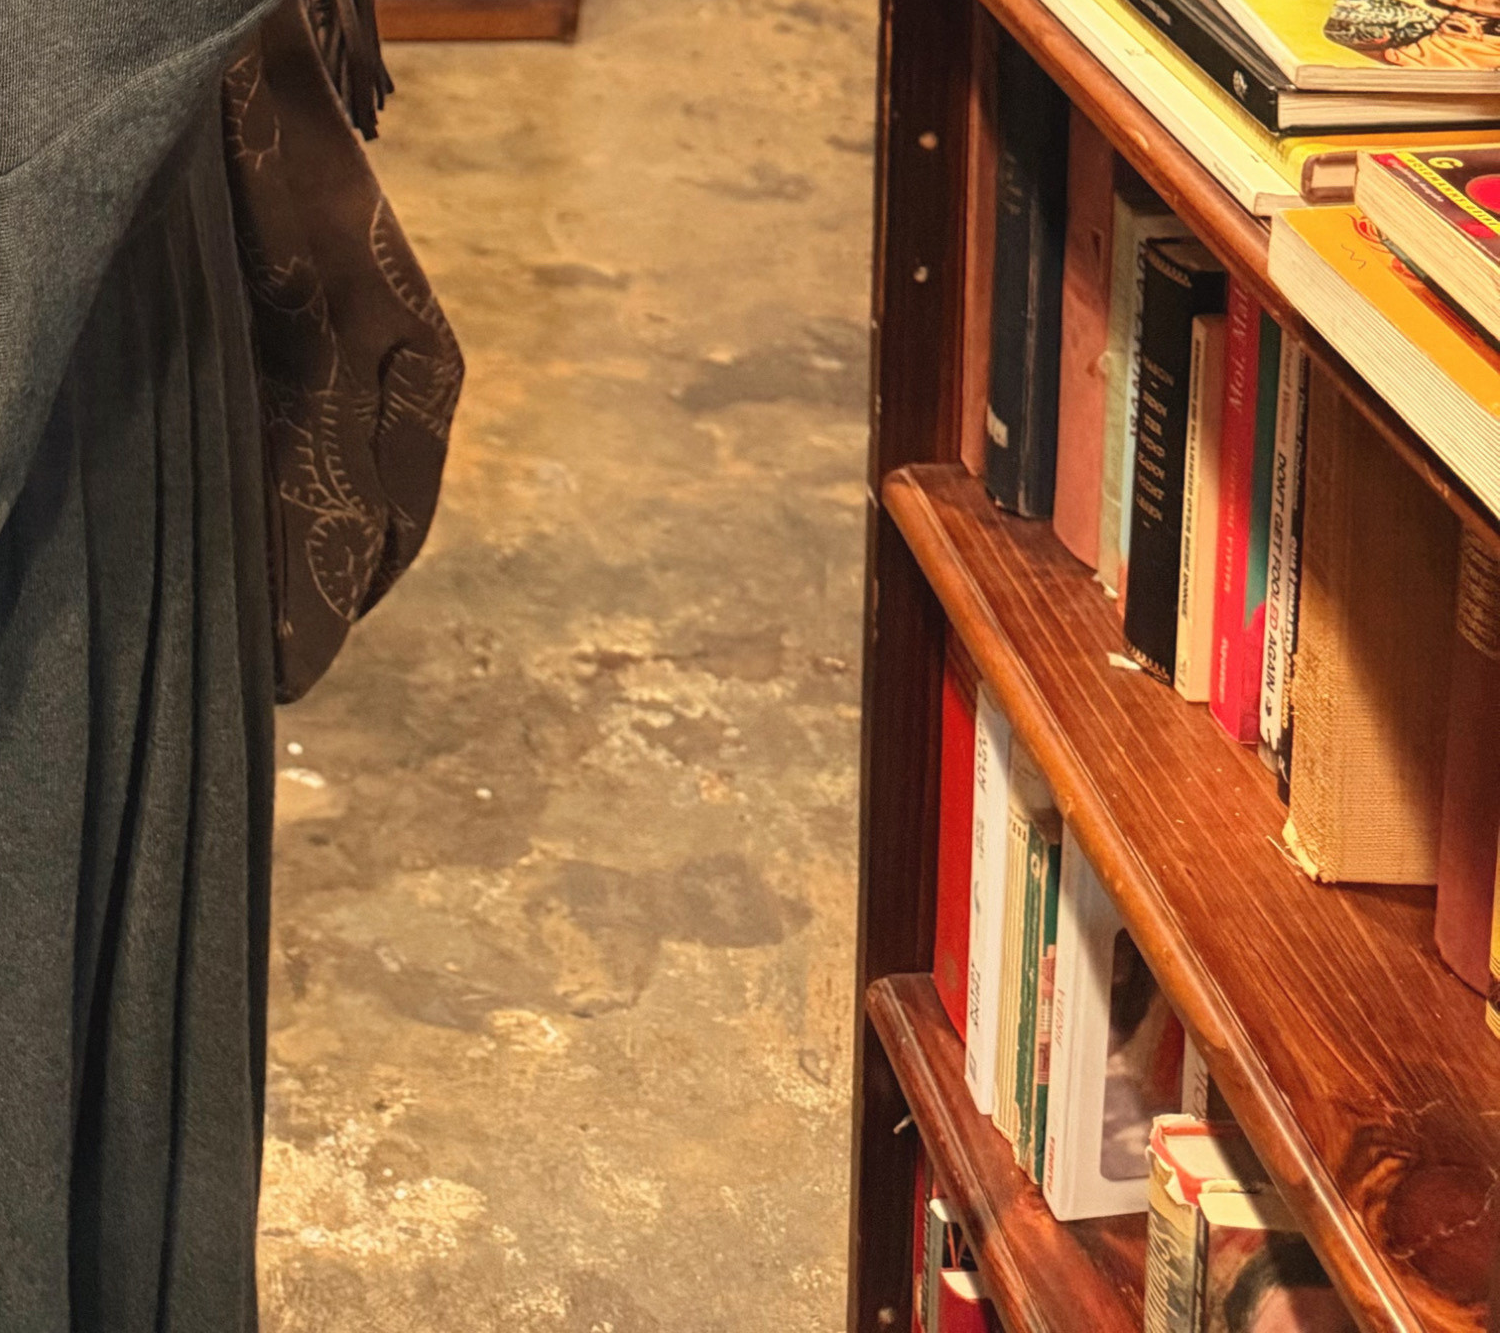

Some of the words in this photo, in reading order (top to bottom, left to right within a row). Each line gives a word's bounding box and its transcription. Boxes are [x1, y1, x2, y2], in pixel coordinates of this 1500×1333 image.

[1428, 156, 1464, 169] G
[1275, 452, 1288, 511] DON'T
[1272, 513, 1285, 556] GET
[1267, 557, 1282, 631] FOOLED
[1264, 631, 1278, 693] AGAIN
